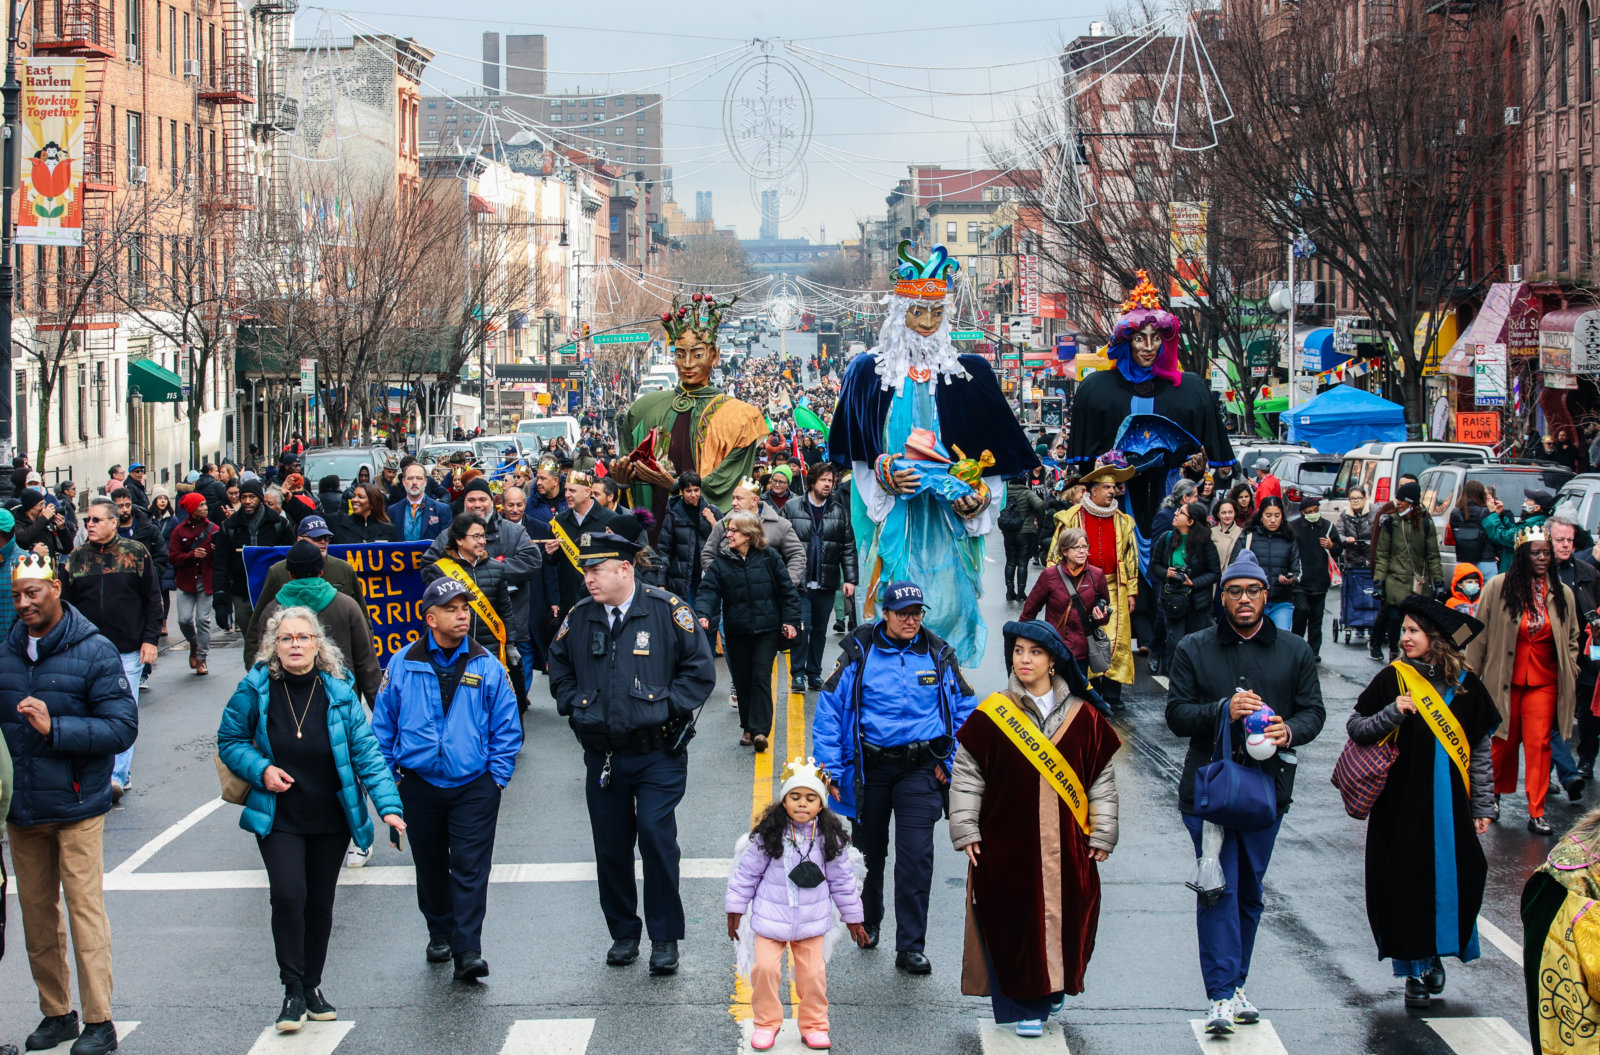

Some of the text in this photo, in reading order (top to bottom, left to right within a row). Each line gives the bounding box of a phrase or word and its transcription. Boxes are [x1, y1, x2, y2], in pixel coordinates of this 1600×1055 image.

[26, 66, 52, 75] East
[26, 76, 71, 86] Harlem
[27, 95, 78, 109] Working
[27, 106, 80, 120] Together
[1028, 288, 1037, 313] SUPPLY
[1510, 318, 1526, 330] Red
[1463, 417, 1492, 426] RAISE
[1464, 430, 1491, 439] PLOW
[346, 550, 423, 572] MUSE
[451, 570, 460, 580] EL
[477, 600, 488, 614] DEL
[894, 586, 922, 600] NYPD
[1421, 696, 1470, 767] EL MUSEO DEL
[995, 705, 1081, 809] EL MUSEO DEL BARRIO
